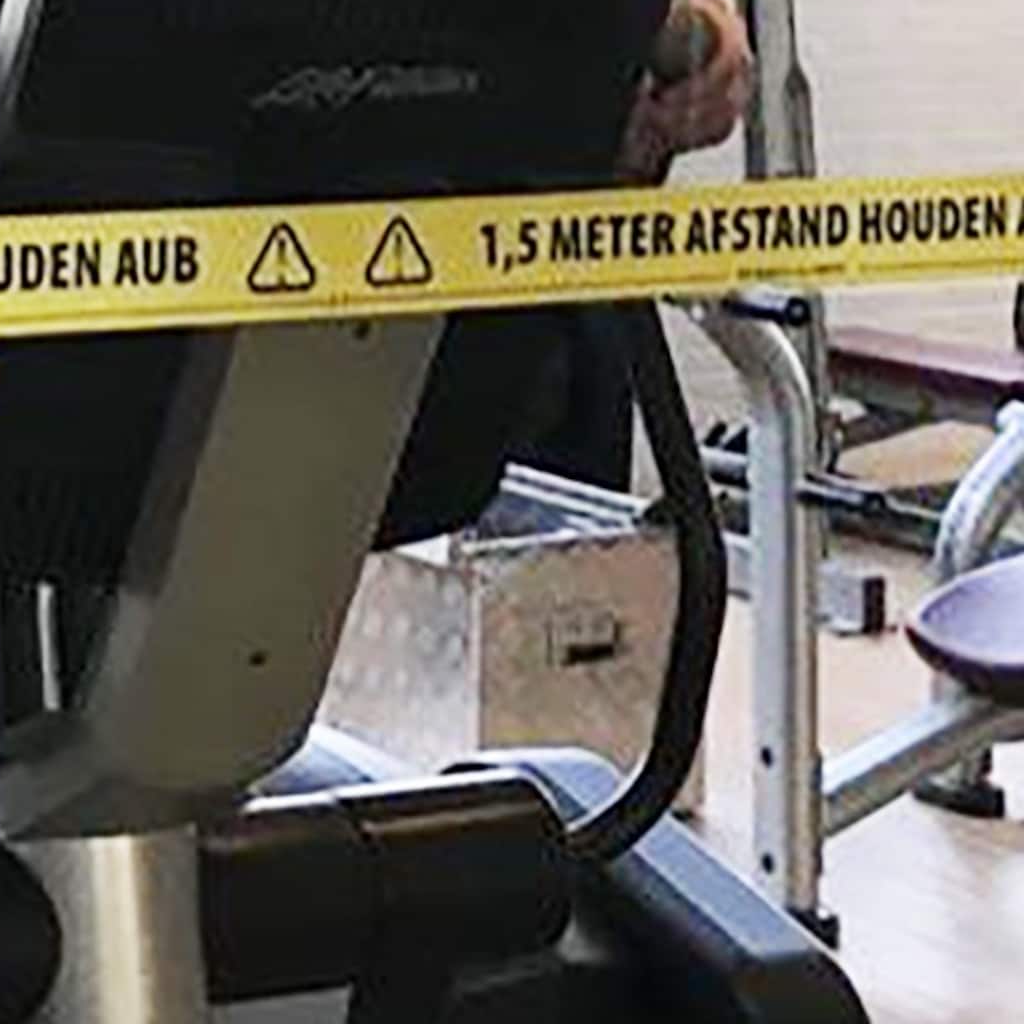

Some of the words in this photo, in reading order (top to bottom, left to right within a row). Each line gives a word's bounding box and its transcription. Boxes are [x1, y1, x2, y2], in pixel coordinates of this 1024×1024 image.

[113, 236, 199, 286] AUB
[479, 219, 539, 273] 1,5
[549, 211, 676, 262] METER
[683, 203, 850, 254] AFSTAND
[859, 195, 1007, 245] HOUDEN
